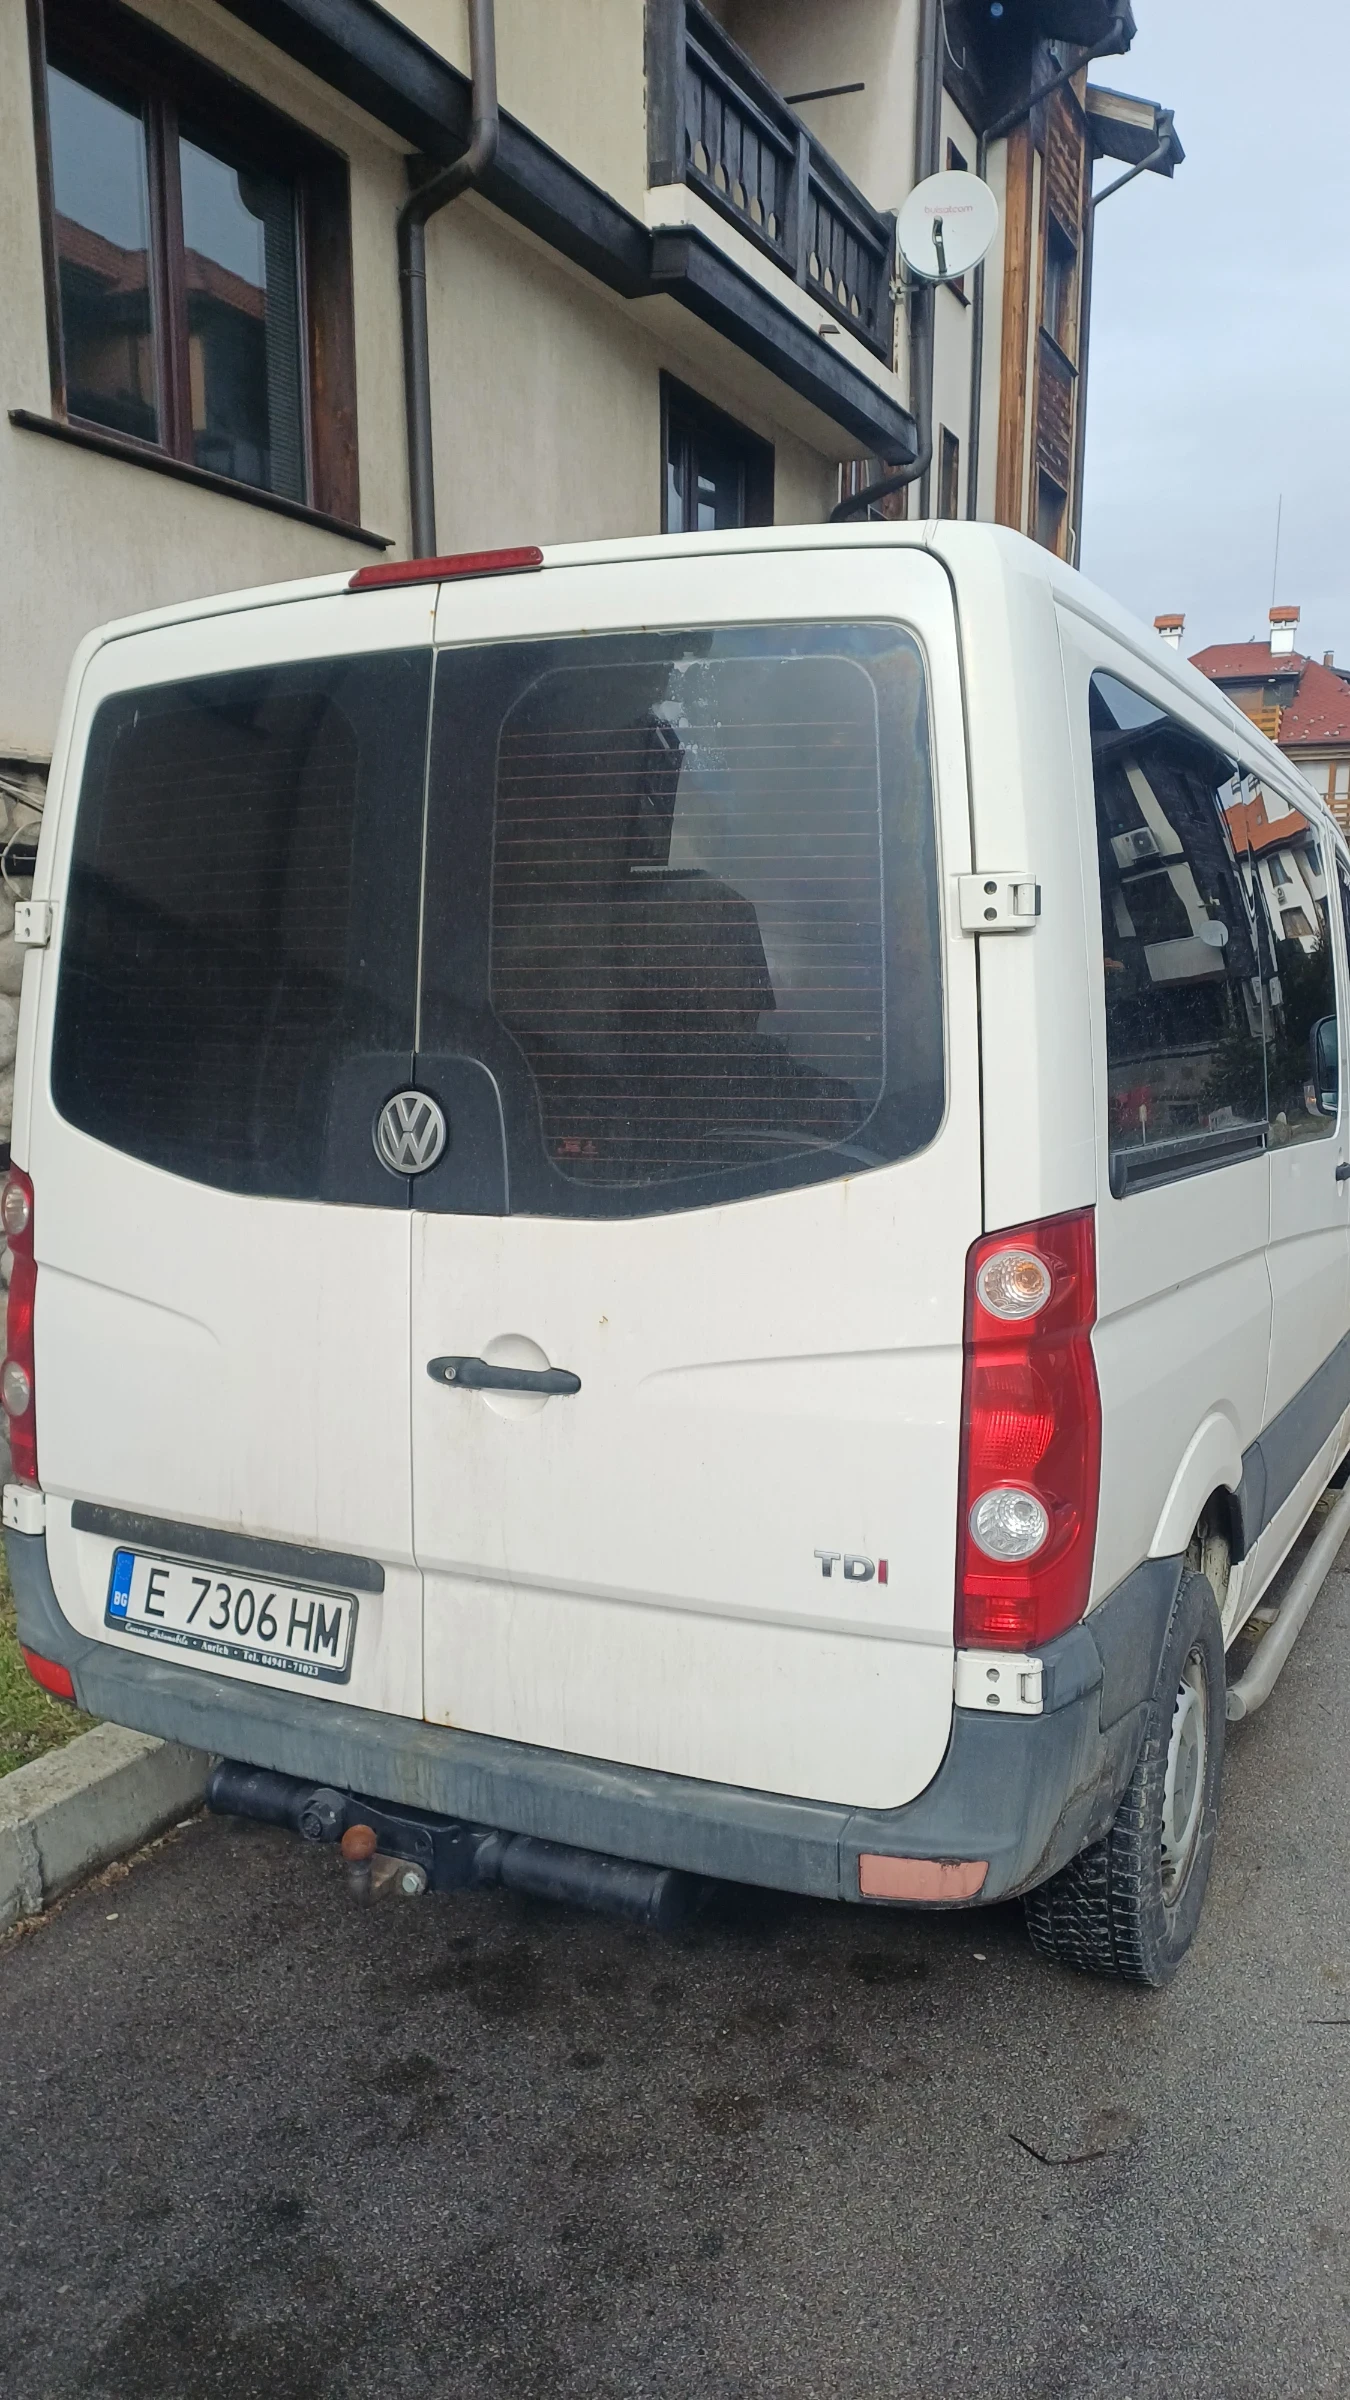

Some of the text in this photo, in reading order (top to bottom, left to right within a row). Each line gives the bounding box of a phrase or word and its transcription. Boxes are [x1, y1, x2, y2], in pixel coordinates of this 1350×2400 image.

[378, 1091, 446, 1173] VW
[814, 1549, 888, 1584] TDI
[113, 1590, 127, 1607] BG
[144, 1568, 342, 1657] E 7306 HM
[201, 1641, 230, 1656] Aurich
[242, 1650, 260, 1663] Tel.
